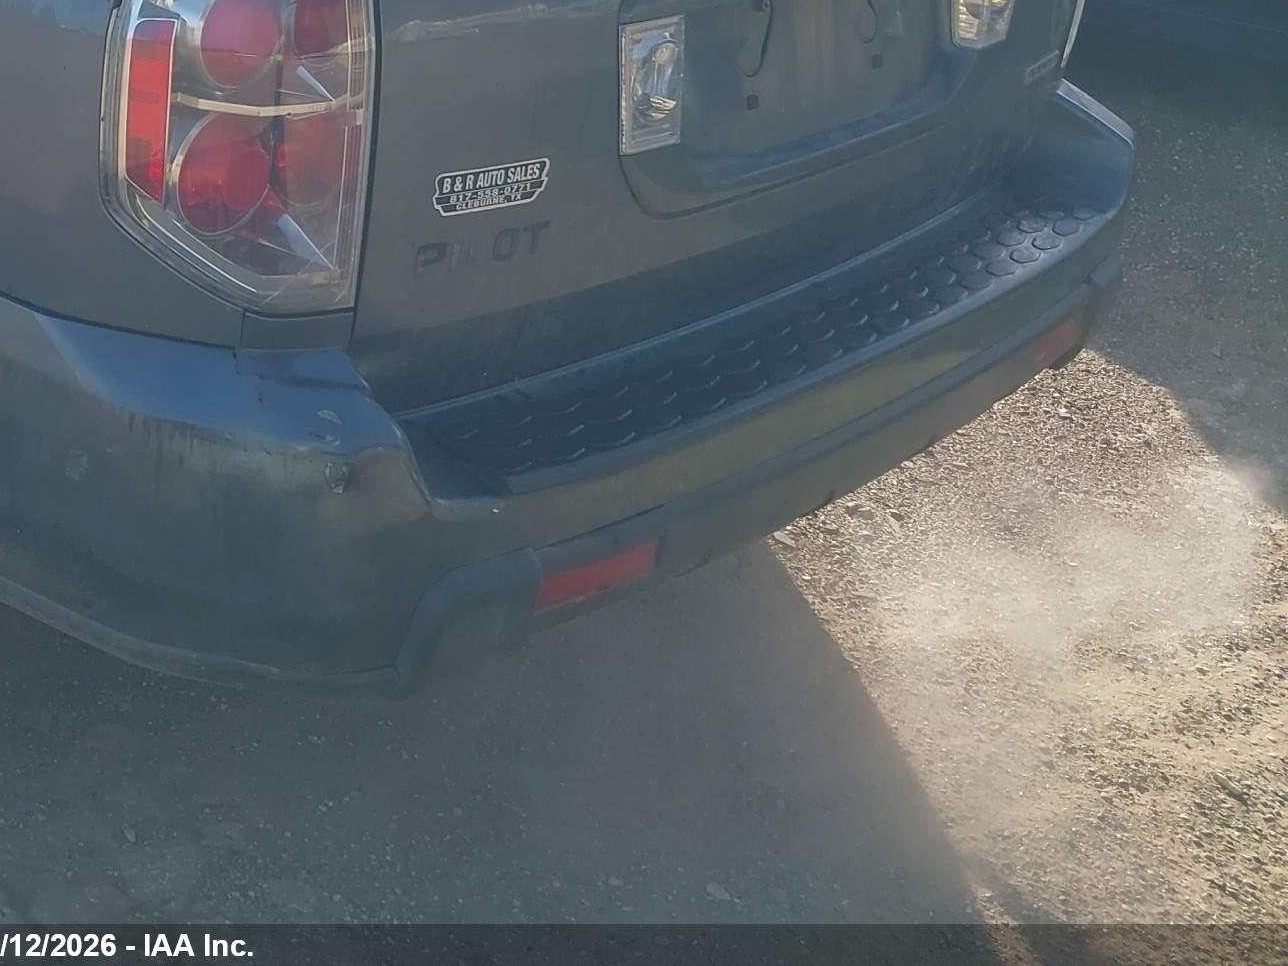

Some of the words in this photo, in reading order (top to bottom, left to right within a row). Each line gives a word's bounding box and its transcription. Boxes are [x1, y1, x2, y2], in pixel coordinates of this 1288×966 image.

[442, 177, 452, 194] B
[453, 176, 464, 192] &
[465, 174, 475, 190] R
[476, 169, 505, 188] AUTO
[507, 163, 542, 183] SALES
[510, 193, 522, 203] TX
